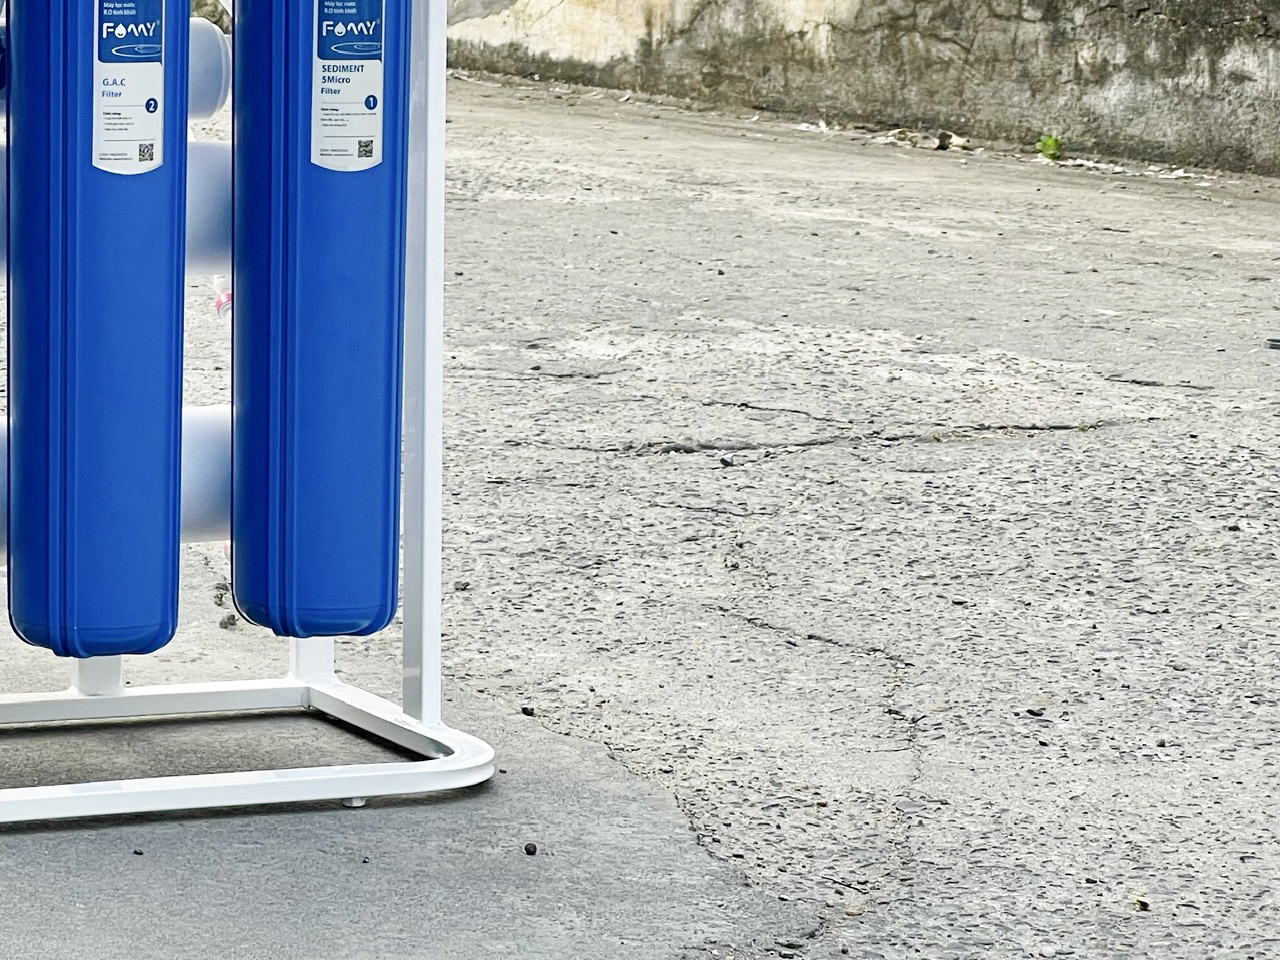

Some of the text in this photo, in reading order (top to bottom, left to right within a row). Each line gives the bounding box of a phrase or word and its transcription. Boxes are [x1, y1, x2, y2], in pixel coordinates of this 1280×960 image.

[322, 64, 364, 73] SEDIMENT
[102, 78, 126, 87] G.A.C
[322, 76, 351, 84] 5Micro
[321, 87, 341, 95] Filter
[149, 100, 155, 112] 2
[369, 97, 374, 108] 1
